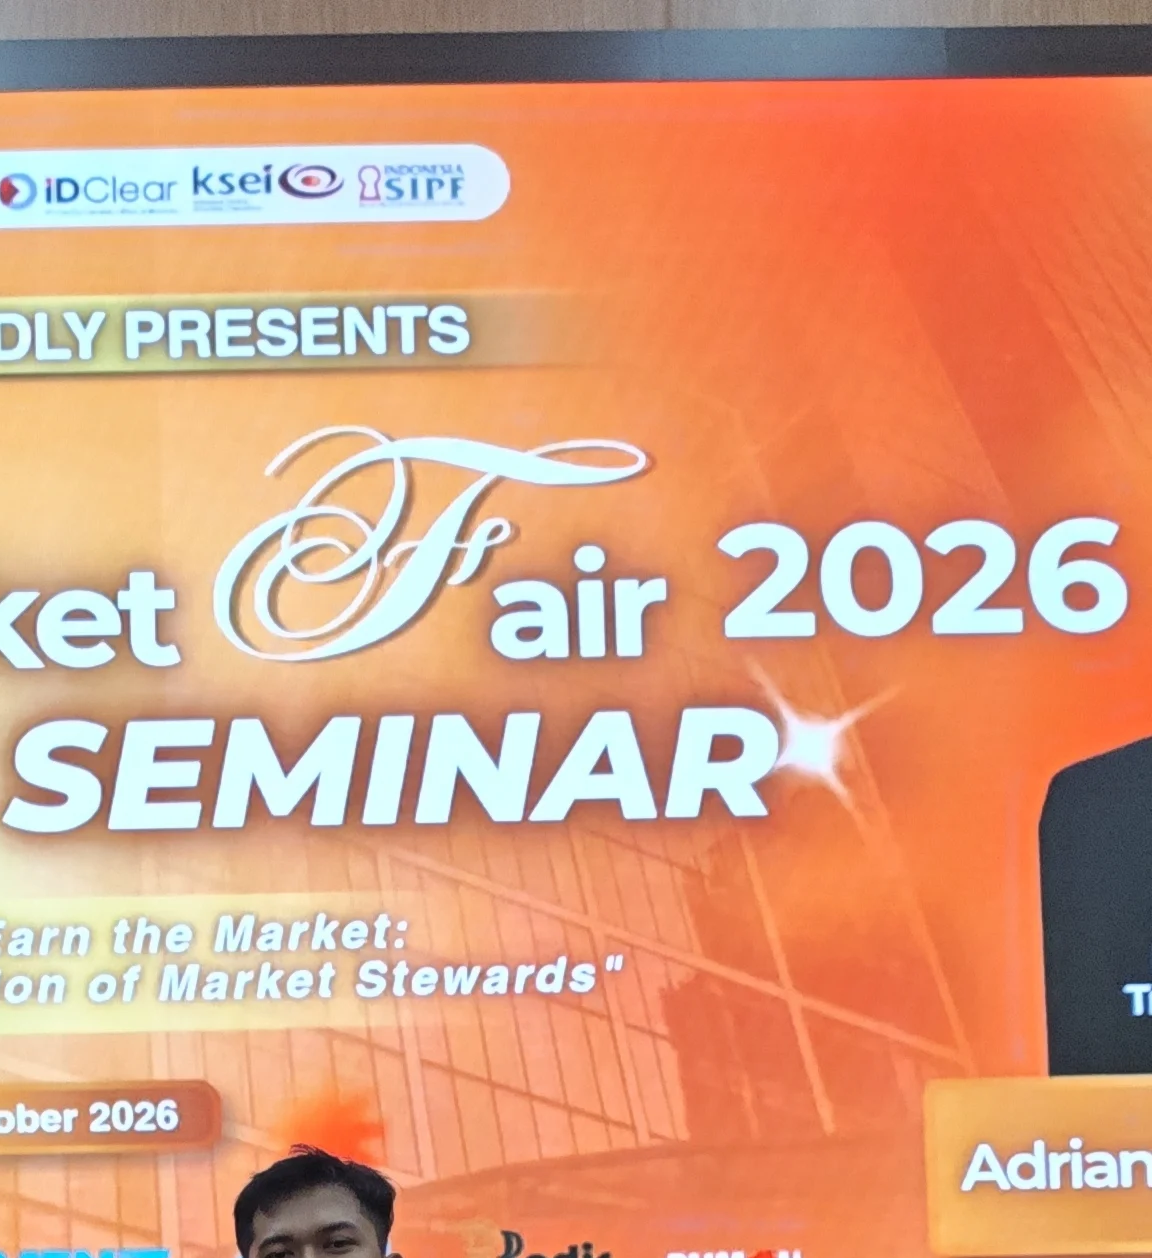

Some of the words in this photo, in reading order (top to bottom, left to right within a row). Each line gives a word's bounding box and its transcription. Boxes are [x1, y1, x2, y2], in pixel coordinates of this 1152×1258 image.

[192, 164, 273, 196] ksei
[124, 305, 470, 359] PRESENTS
[213, 425, 667, 660] Fair
[716, 516, 1129, 638] 2026
[1, 706, 780, 833] SEMINAR
[113, 916, 192, 954] the
[214, 913, 408, 952] Market:
[87, 963, 142, 1002] of
[158, 961, 336, 1001] Market
[355, 954, 624, 998] Stewards"
[89, 1099, 179, 1133] 2026
